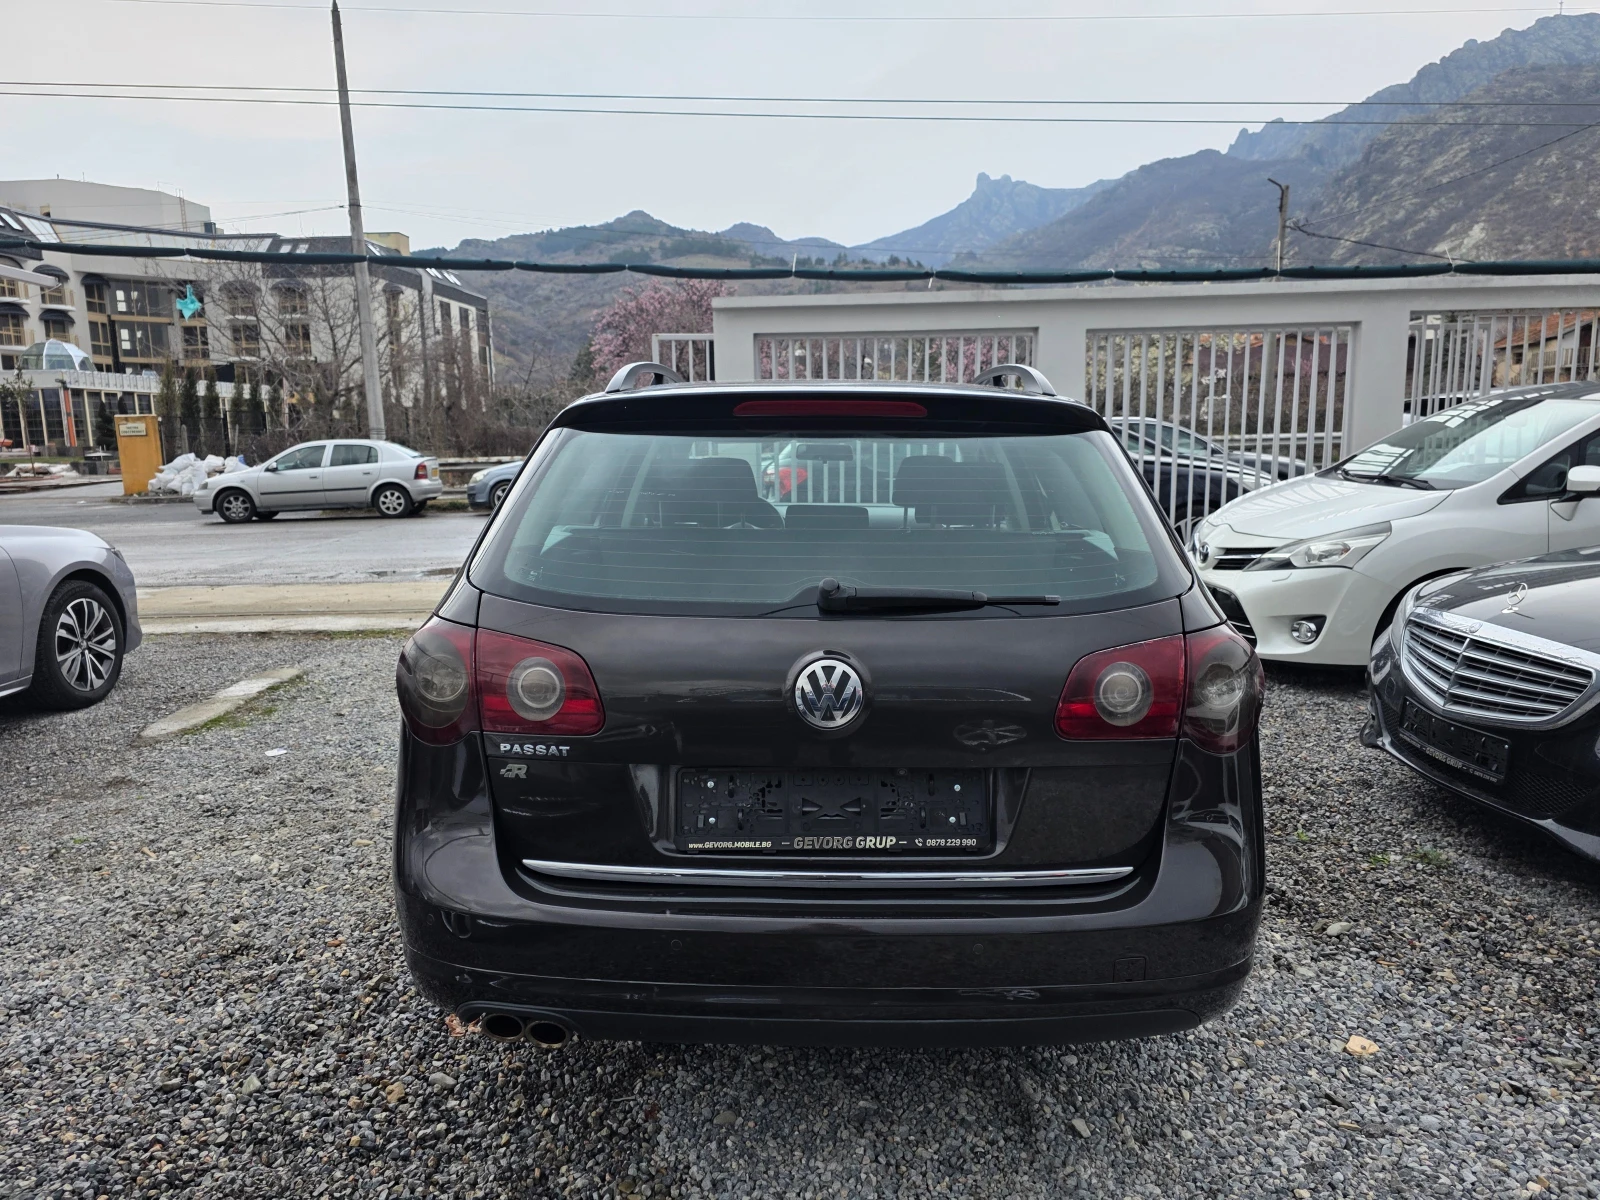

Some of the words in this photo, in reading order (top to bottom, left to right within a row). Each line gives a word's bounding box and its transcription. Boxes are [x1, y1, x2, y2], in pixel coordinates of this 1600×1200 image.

[499, 743, 570, 757] PASSAT
[688, 841, 772, 849] www.GEVORG.MOBILE.BG
[793, 836, 853, 849] GEVORG
[855, 836, 897, 849] GRUP
[926, 838, 945, 847] 0878
[946, 838, 961, 847] 229
[961, 838, 977, 847] 990
